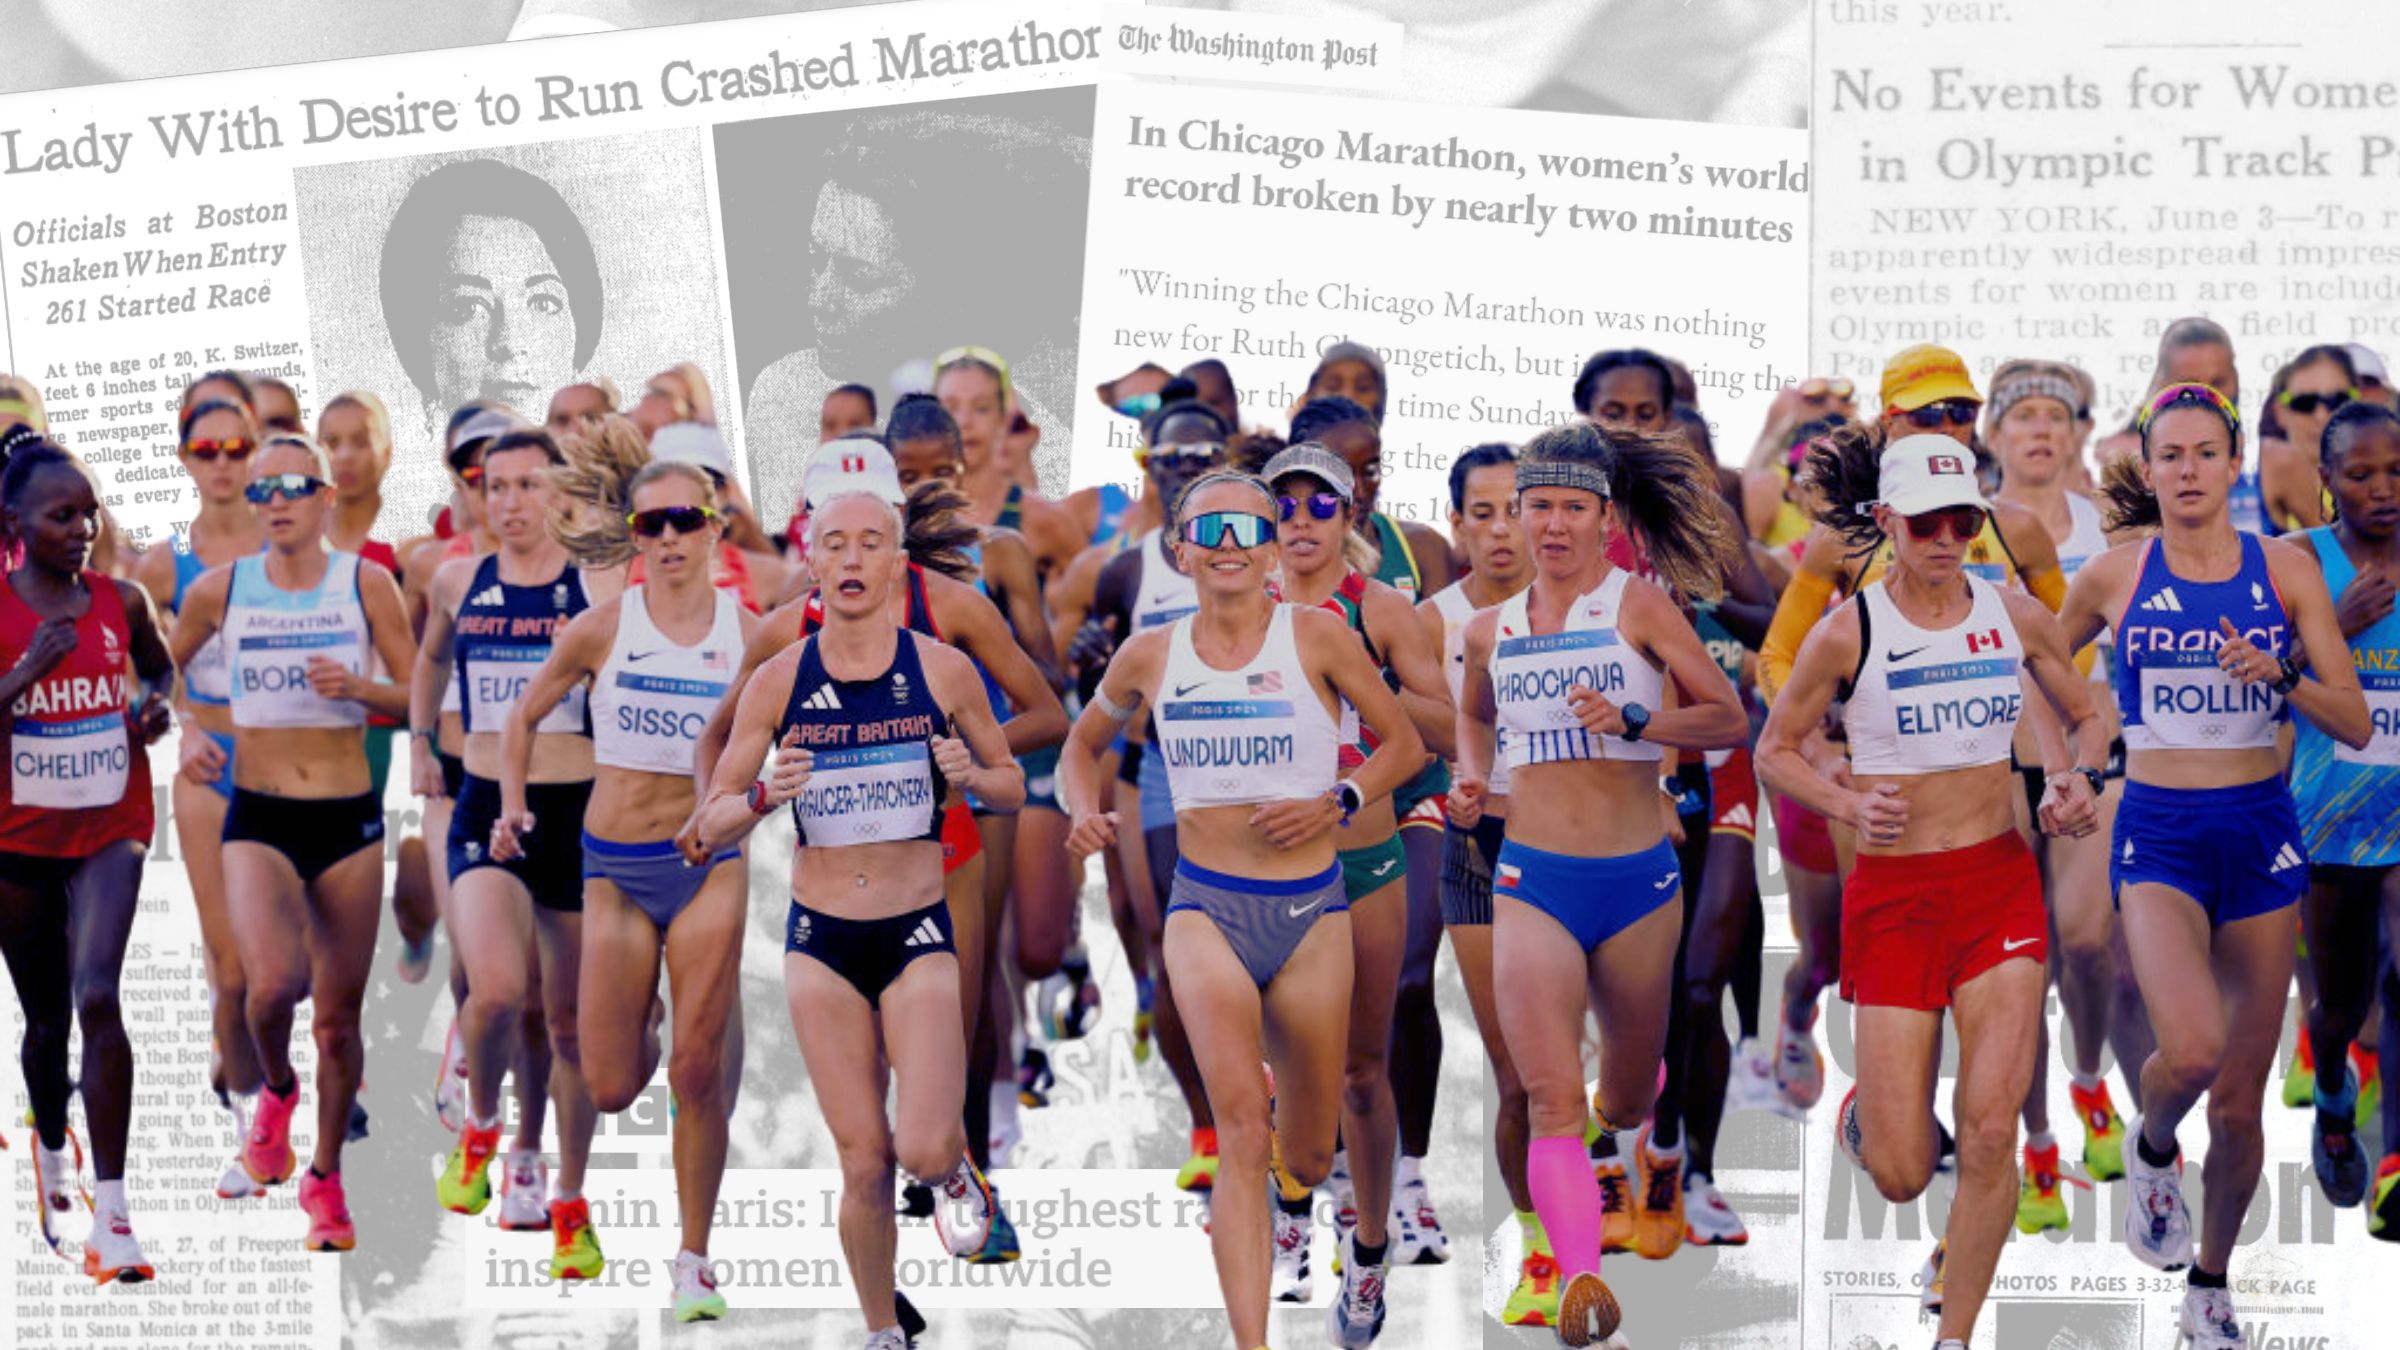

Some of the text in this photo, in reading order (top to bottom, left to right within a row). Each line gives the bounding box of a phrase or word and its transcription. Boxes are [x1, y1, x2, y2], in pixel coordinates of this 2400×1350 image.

[1830, 0, 2013, 28] this year.
[1118, 22, 1378, 71] The Washington Post
[1831, 68, 1901, 112] No
[1930, 67, 2101, 112] Events
[2128, 66, 2202, 109] for
[1, 123, 133, 175] Lady
[148, 106, 284, 159] With
[300, 92, 458, 145] Desire
[475, 85, 521, 127] to
[536, 74, 643, 122] Run
[660, 42, 859, 107] Crashed
[1128, 116, 1166, 147] In
[1178, 119, 1324, 169] Chicago
[1335, 129, 1525, 180] Marathon,
[1705, 159, 1809, 193] world
[1861, 141, 1907, 183] in
[1937, 137, 2153, 188] Olympic
[2183, 135, 2331, 178] Track
[1124, 172, 1793, 243] record broken by nearly two minutes
[1870, 208, 1976, 234] NEW
[1996, 206, 2127, 235] YORK,
[2148, 205, 2238, 231] June
[13, 203, 288, 247] Officials at Boston
[21, 242, 287, 287] Shaken When Entry
[1829, 243, 2031, 273] apparently
[2052, 241, 2258, 269] widespread
[46, 283, 271, 325] 261 Started Race
[1830, 278, 2258, 305] events for women are
[1119, 268, 1767, 350] "Winning the Chicago Marathon was nothing
[1830, 314, 1986, 345] Olympic
[2014, 312, 2112, 338] track
[2239, 310, 2317, 337] field
[44, 341, 304, 380] At the age of 20, K. Switzer,
[1113, 326, 1173, 349] new
[1181, 323, 1222, 352] for
[1230, 328, 1305, 359] Ruth
[1516, 347, 1569, 378] but
[1754, 364, 1797, 392] the
[45, 382, 79, 401] feet
[86, 381, 96, 398] 6
[103, 376, 157, 396] inches
[101, 401, 153, 420] sports
[1398, 393, 1461, 421] time
[78, 424, 172, 446] newspaper,
[84, 444, 142, 464] college
[1405, 443, 1447, 470] the
[134, 488, 181, 504] every
[246, 612, 344, 631] ARGENTINA
[2126, 624, 2285, 668] FRANCE
[2153, 684, 2273, 714] ROLLIN
[1896, 693, 2022, 735] ELMORE
[790, 714, 934, 745] GREAT BRITAIN
[14, 745, 129, 779] CHELIMO
[125, 964, 192, 981] suffered
[122, 986, 191, 1002] received
[132, 1007, 165, 1022] wall
[147, 1049, 173, 1064] the
[140, 1070, 203, 1088] thought
[176, 1096, 196, 1109] up
[138, 1113, 233, 1131] going to be
[168, 1132, 214, 1148] When
[147, 1153, 228, 1171] yesterday,
[128, 1176, 216, 1190] the winner
[174, 1195, 263, 1213] in Olympic
[16, 1220, 37, 1236] ry.
[32, 1236, 226, 1254] In 27, of
[16, 1257, 312, 1276] Maine, of the fastest
[16, 1280, 53, 1297] field
[63, 1284, 98, 1296] ever
[203, 1279, 227, 1295] for
[237, 1282, 257, 1295] an
[267, 1277, 314, 1294] all-fe-
[1823, 1270, 1901, 1289] STORIES,
[2071, 1276, 2127, 1292] PAGES
[2269, 1280, 2316, 1294] PAGE
[16, 1299, 313, 1318] male marathon. She broke out of the
[16, 1319, 313, 1343] pack in Santa Monica at the 3-mile
